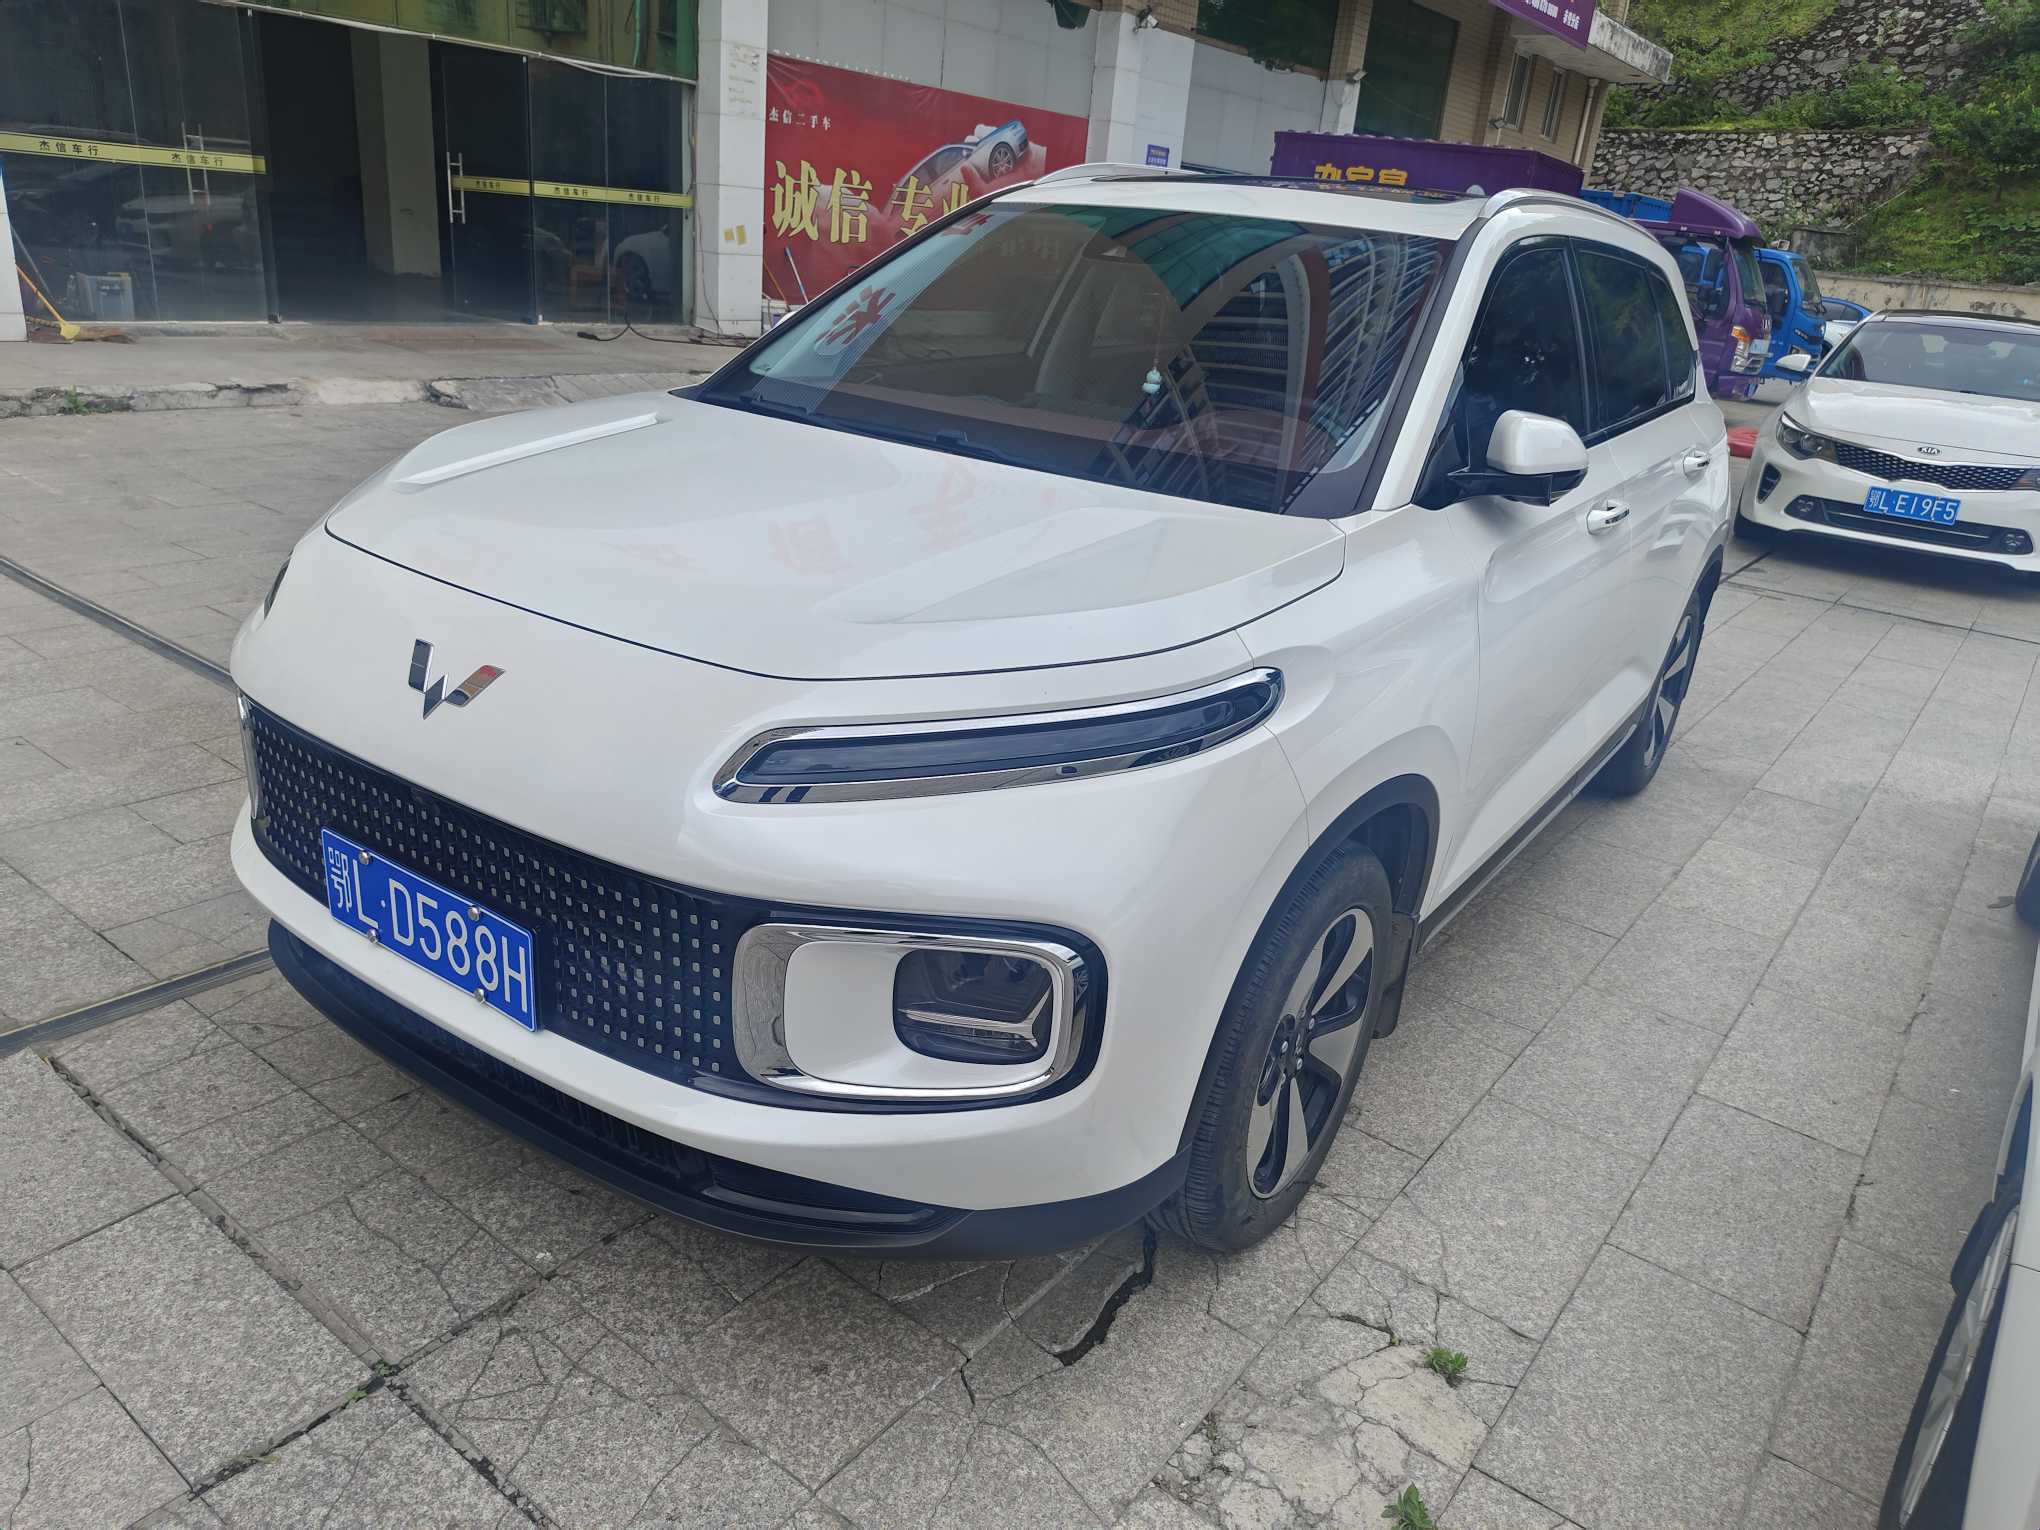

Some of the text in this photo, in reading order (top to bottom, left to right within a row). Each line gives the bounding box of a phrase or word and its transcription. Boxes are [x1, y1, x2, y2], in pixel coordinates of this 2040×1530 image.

[39, 139, 98, 156] 杰信车行
[171, 152, 223, 167] 杰信车行
[770, 159, 873, 243] 诚信
[328, 847, 528, 1014] 鄂L·D588H
